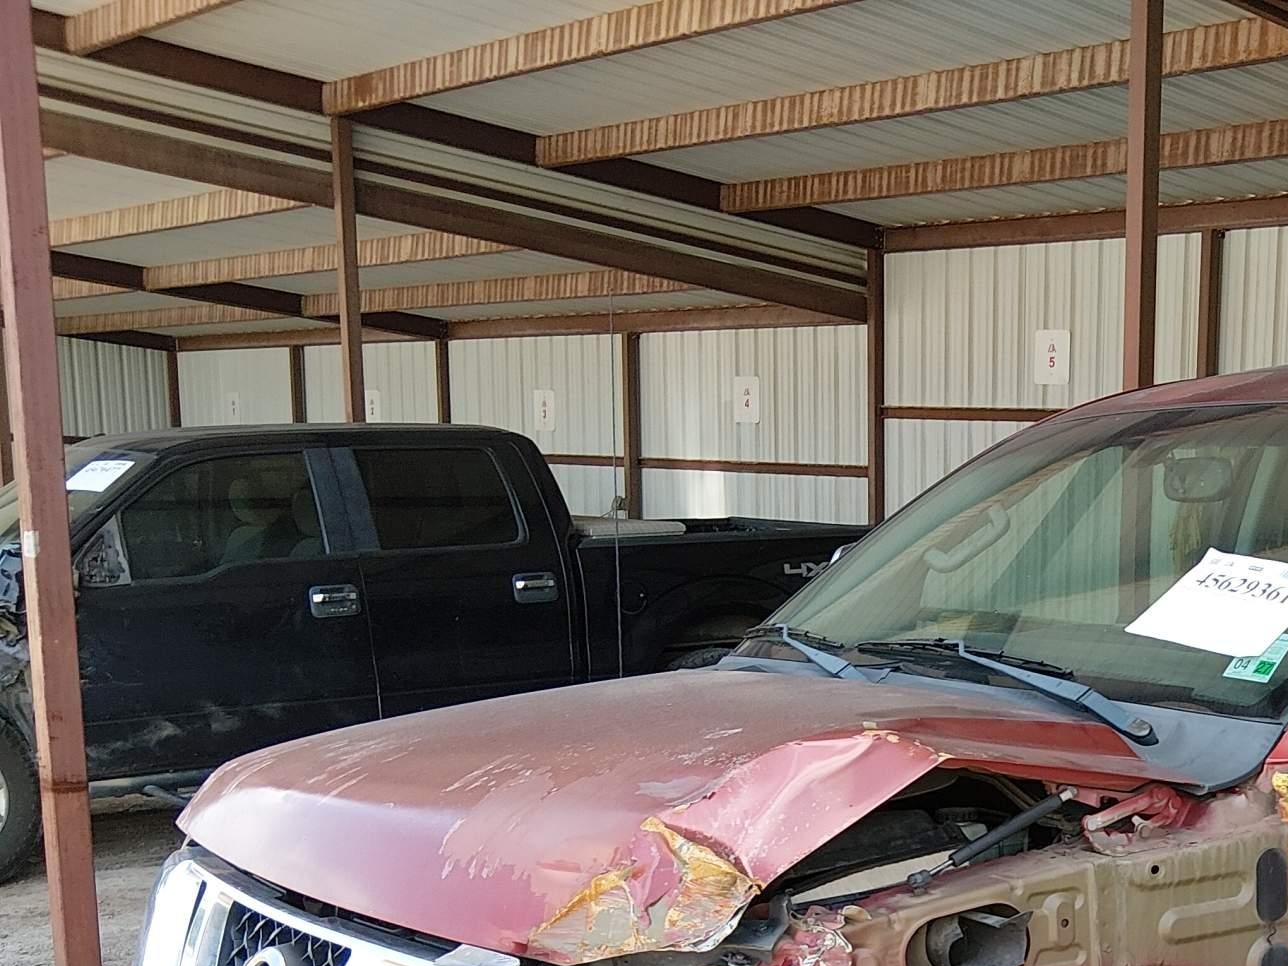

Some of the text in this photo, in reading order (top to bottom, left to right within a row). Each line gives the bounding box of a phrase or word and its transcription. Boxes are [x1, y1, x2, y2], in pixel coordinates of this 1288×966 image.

[1049, 356, 1056, 368] 5
[783, 561, 830, 578] 4X
[1233, 658, 1252, 671] 04
[1253, 661, 1277, 676] 27
